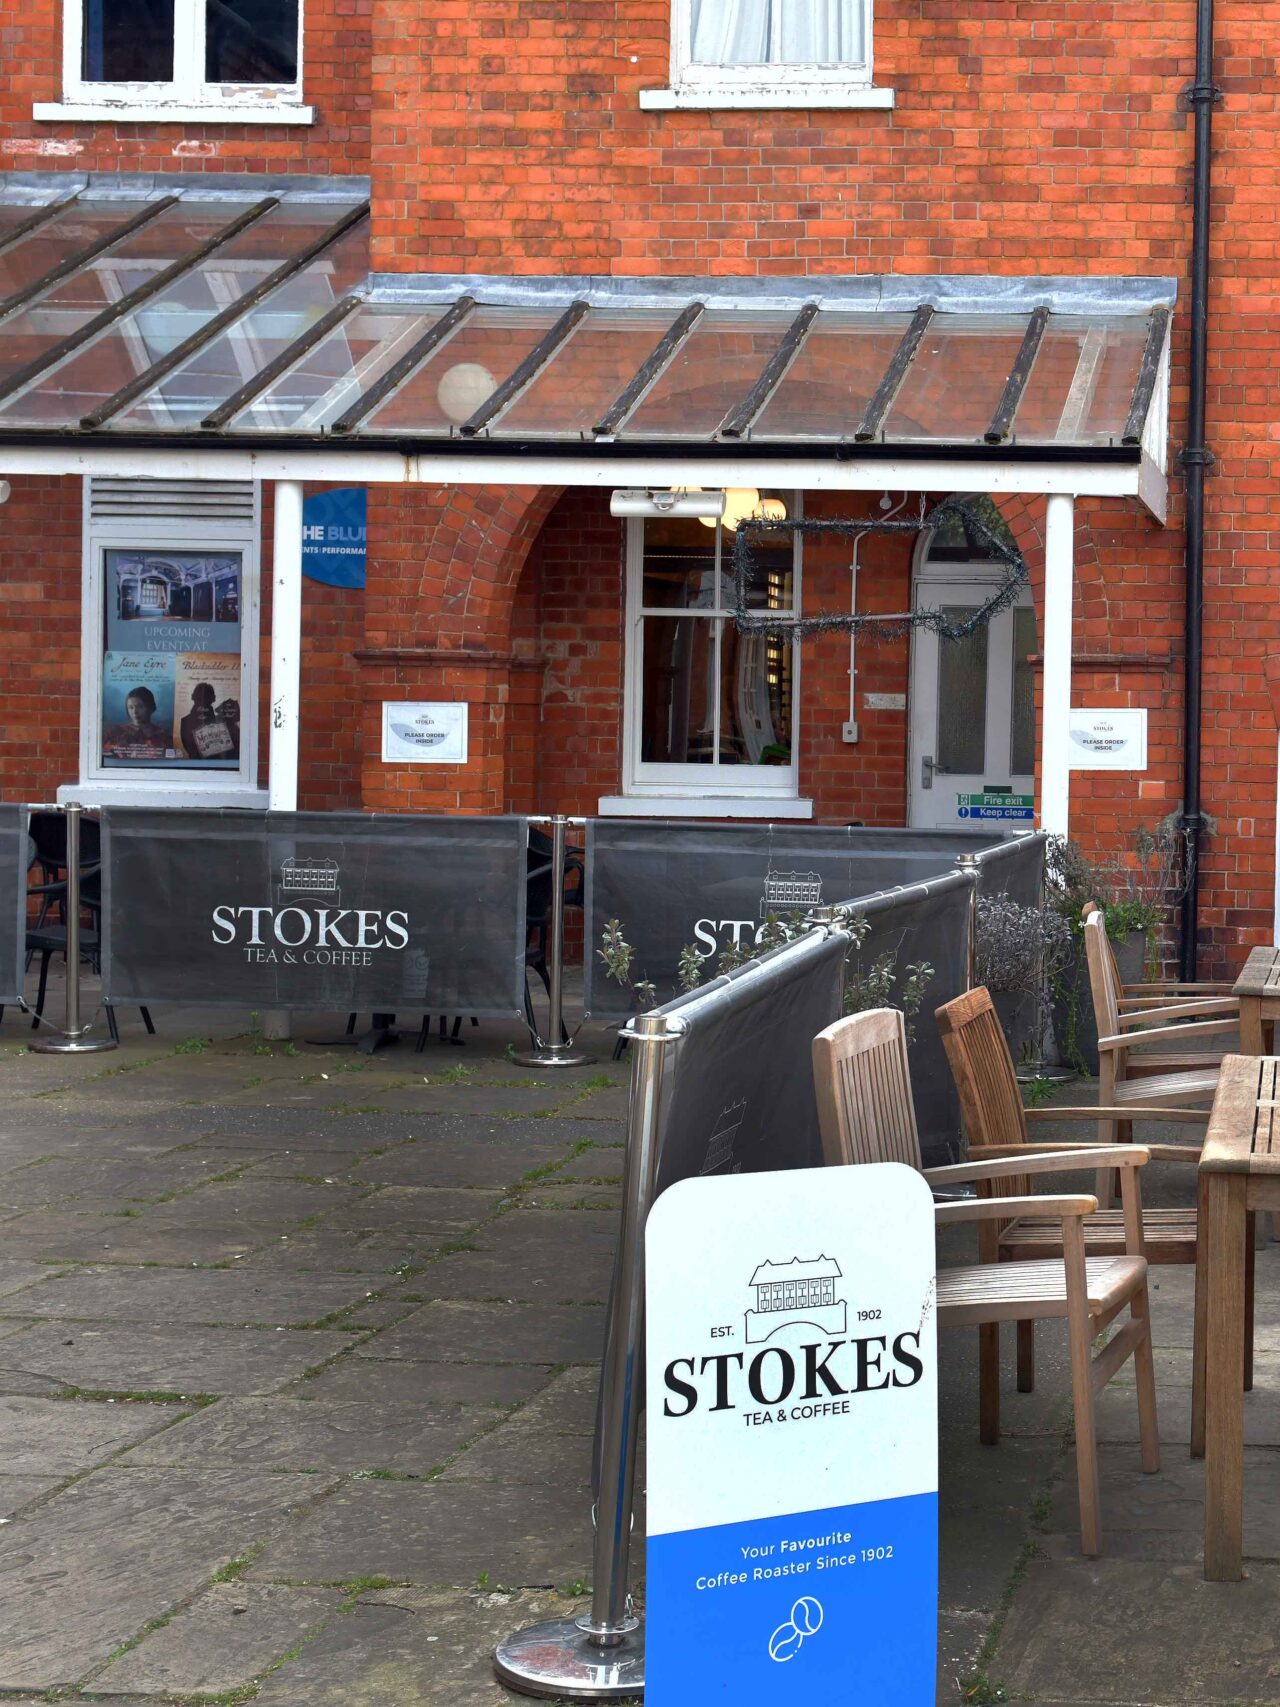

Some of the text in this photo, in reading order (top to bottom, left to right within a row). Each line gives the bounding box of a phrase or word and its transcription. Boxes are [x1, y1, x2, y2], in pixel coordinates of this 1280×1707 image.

[302, 525, 324, 541] HE
[301, 546, 319, 554] NTS
[144, 626, 210, 638] UPCOMING
[146, 640, 208, 651] EVENTS AT
[983, 796, 1023, 805] Fire exit
[980, 808, 1002, 818] Keep
[211, 905, 409, 950] STOKES
[243, 947, 373, 966] TEA & COFFEE
[710, 1309, 882, 1338] EST. 1902
[663, 1330, 924, 1417] STOKES
[743, 1400, 850, 1427] TEA & COFFEE
[741, 1531, 852, 1560] Your Favourite
[696, 1545, 894, 1590] Coffee Roaster Since 1902
